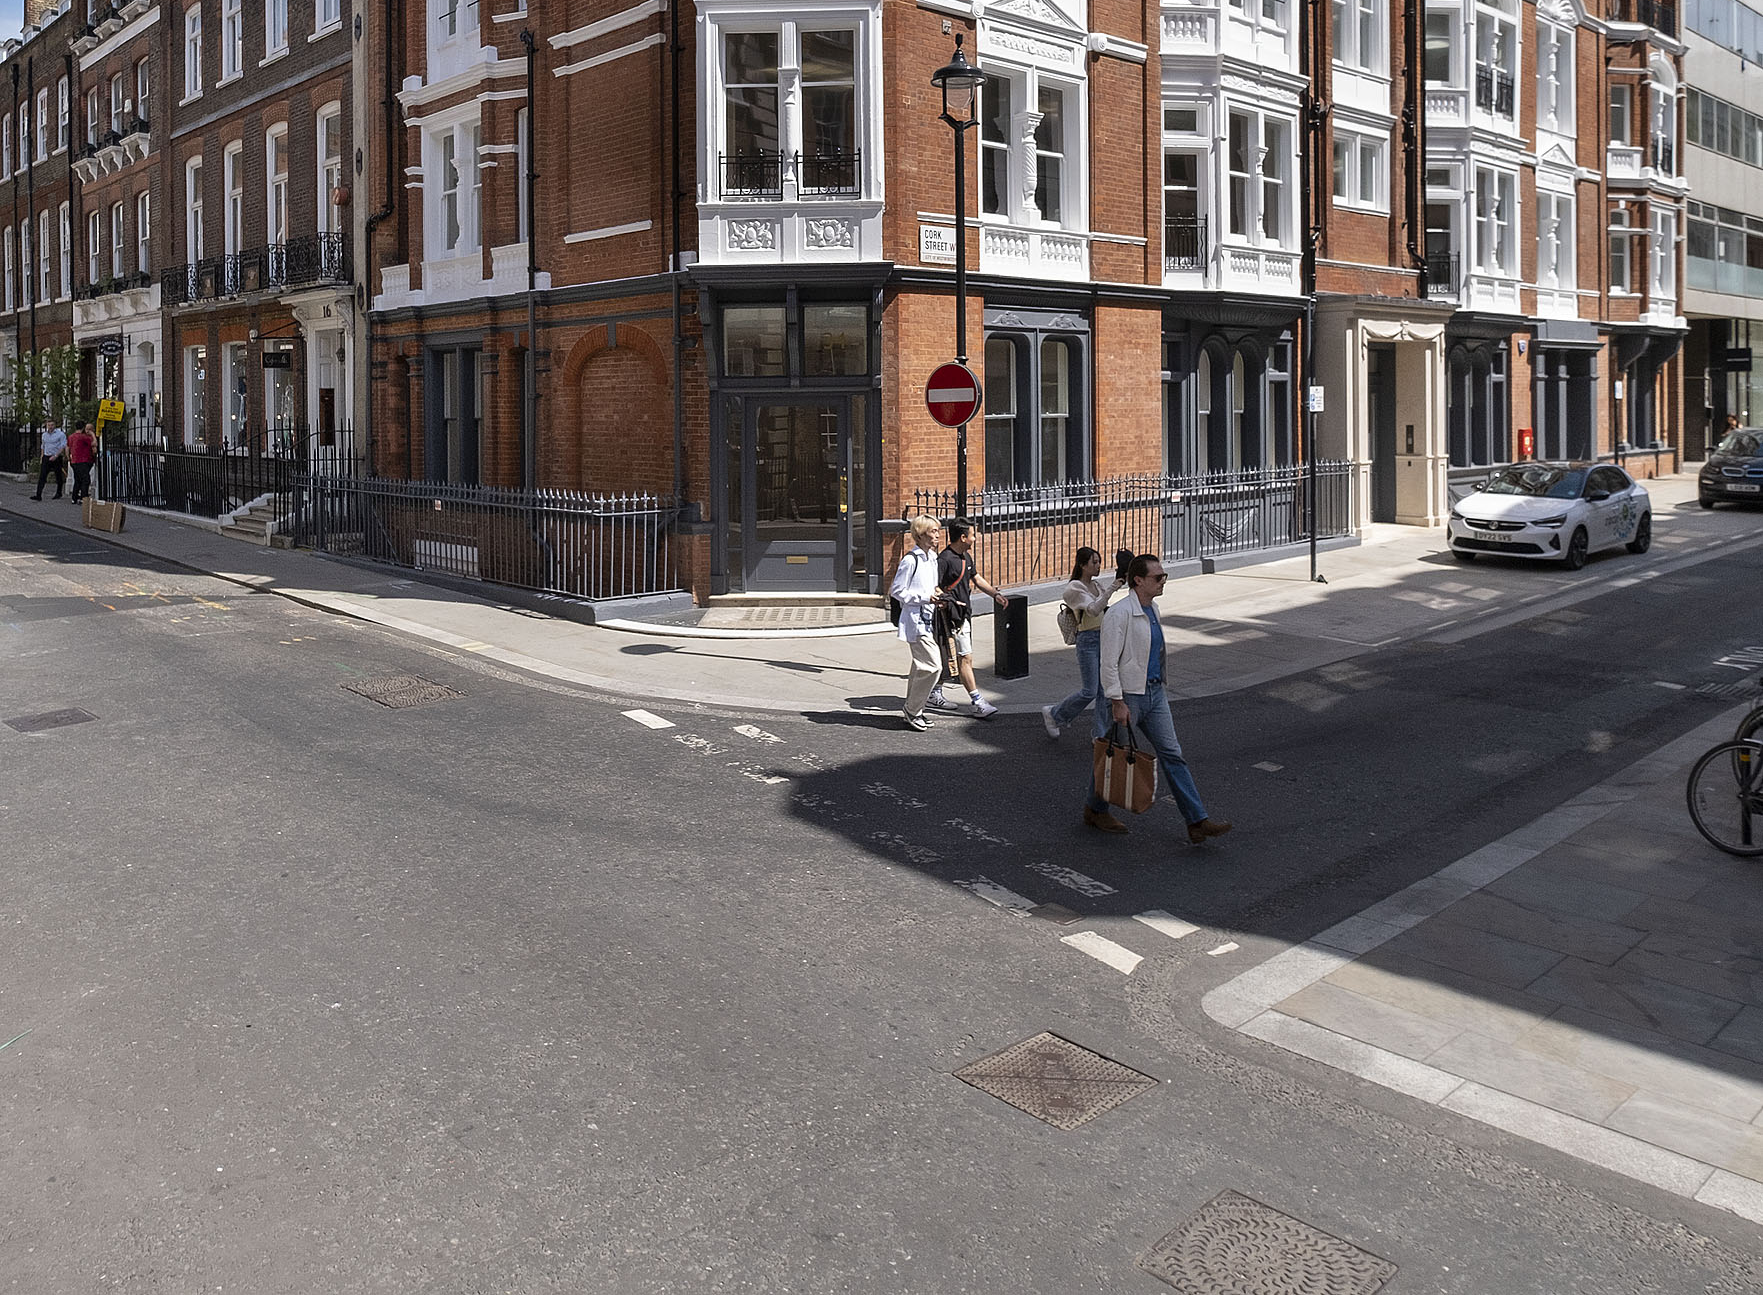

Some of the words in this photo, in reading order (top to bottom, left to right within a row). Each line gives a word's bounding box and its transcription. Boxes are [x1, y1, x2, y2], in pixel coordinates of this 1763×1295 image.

[925, 230, 942, 240] CORK
[925, 241, 948, 251] STREET
[949, 243, 957, 252] W
[323, 304, 332, 318] 16
